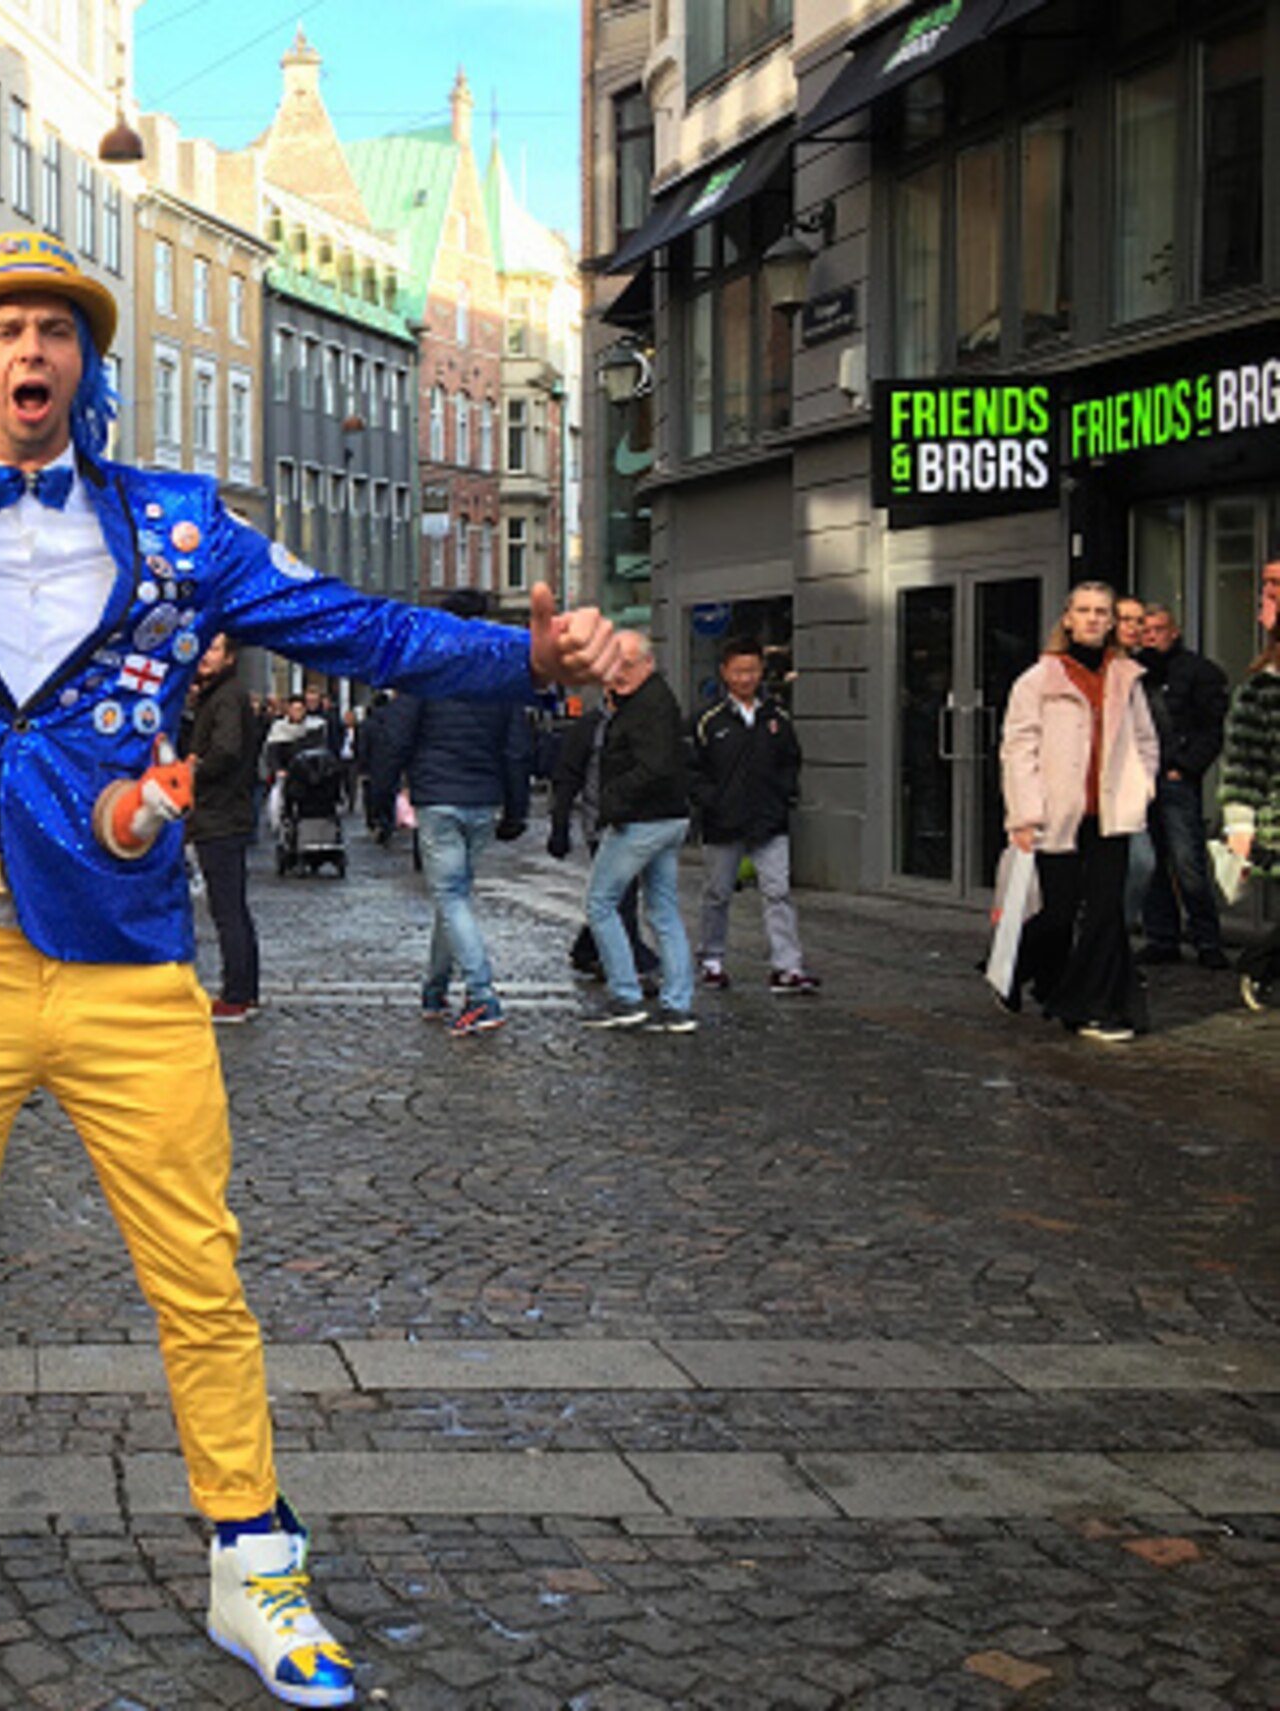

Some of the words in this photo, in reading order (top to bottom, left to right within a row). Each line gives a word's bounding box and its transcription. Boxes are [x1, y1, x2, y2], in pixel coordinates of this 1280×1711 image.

[891, 386, 1049, 440] FRIENDS
[1072, 378, 1192, 459] FRIENDS
[1194, 374, 1213, 437] &
[1218, 358, 1280, 432] BRG
[891, 443, 912, 493] &
[918, 438, 1049, 493] BRGRS
